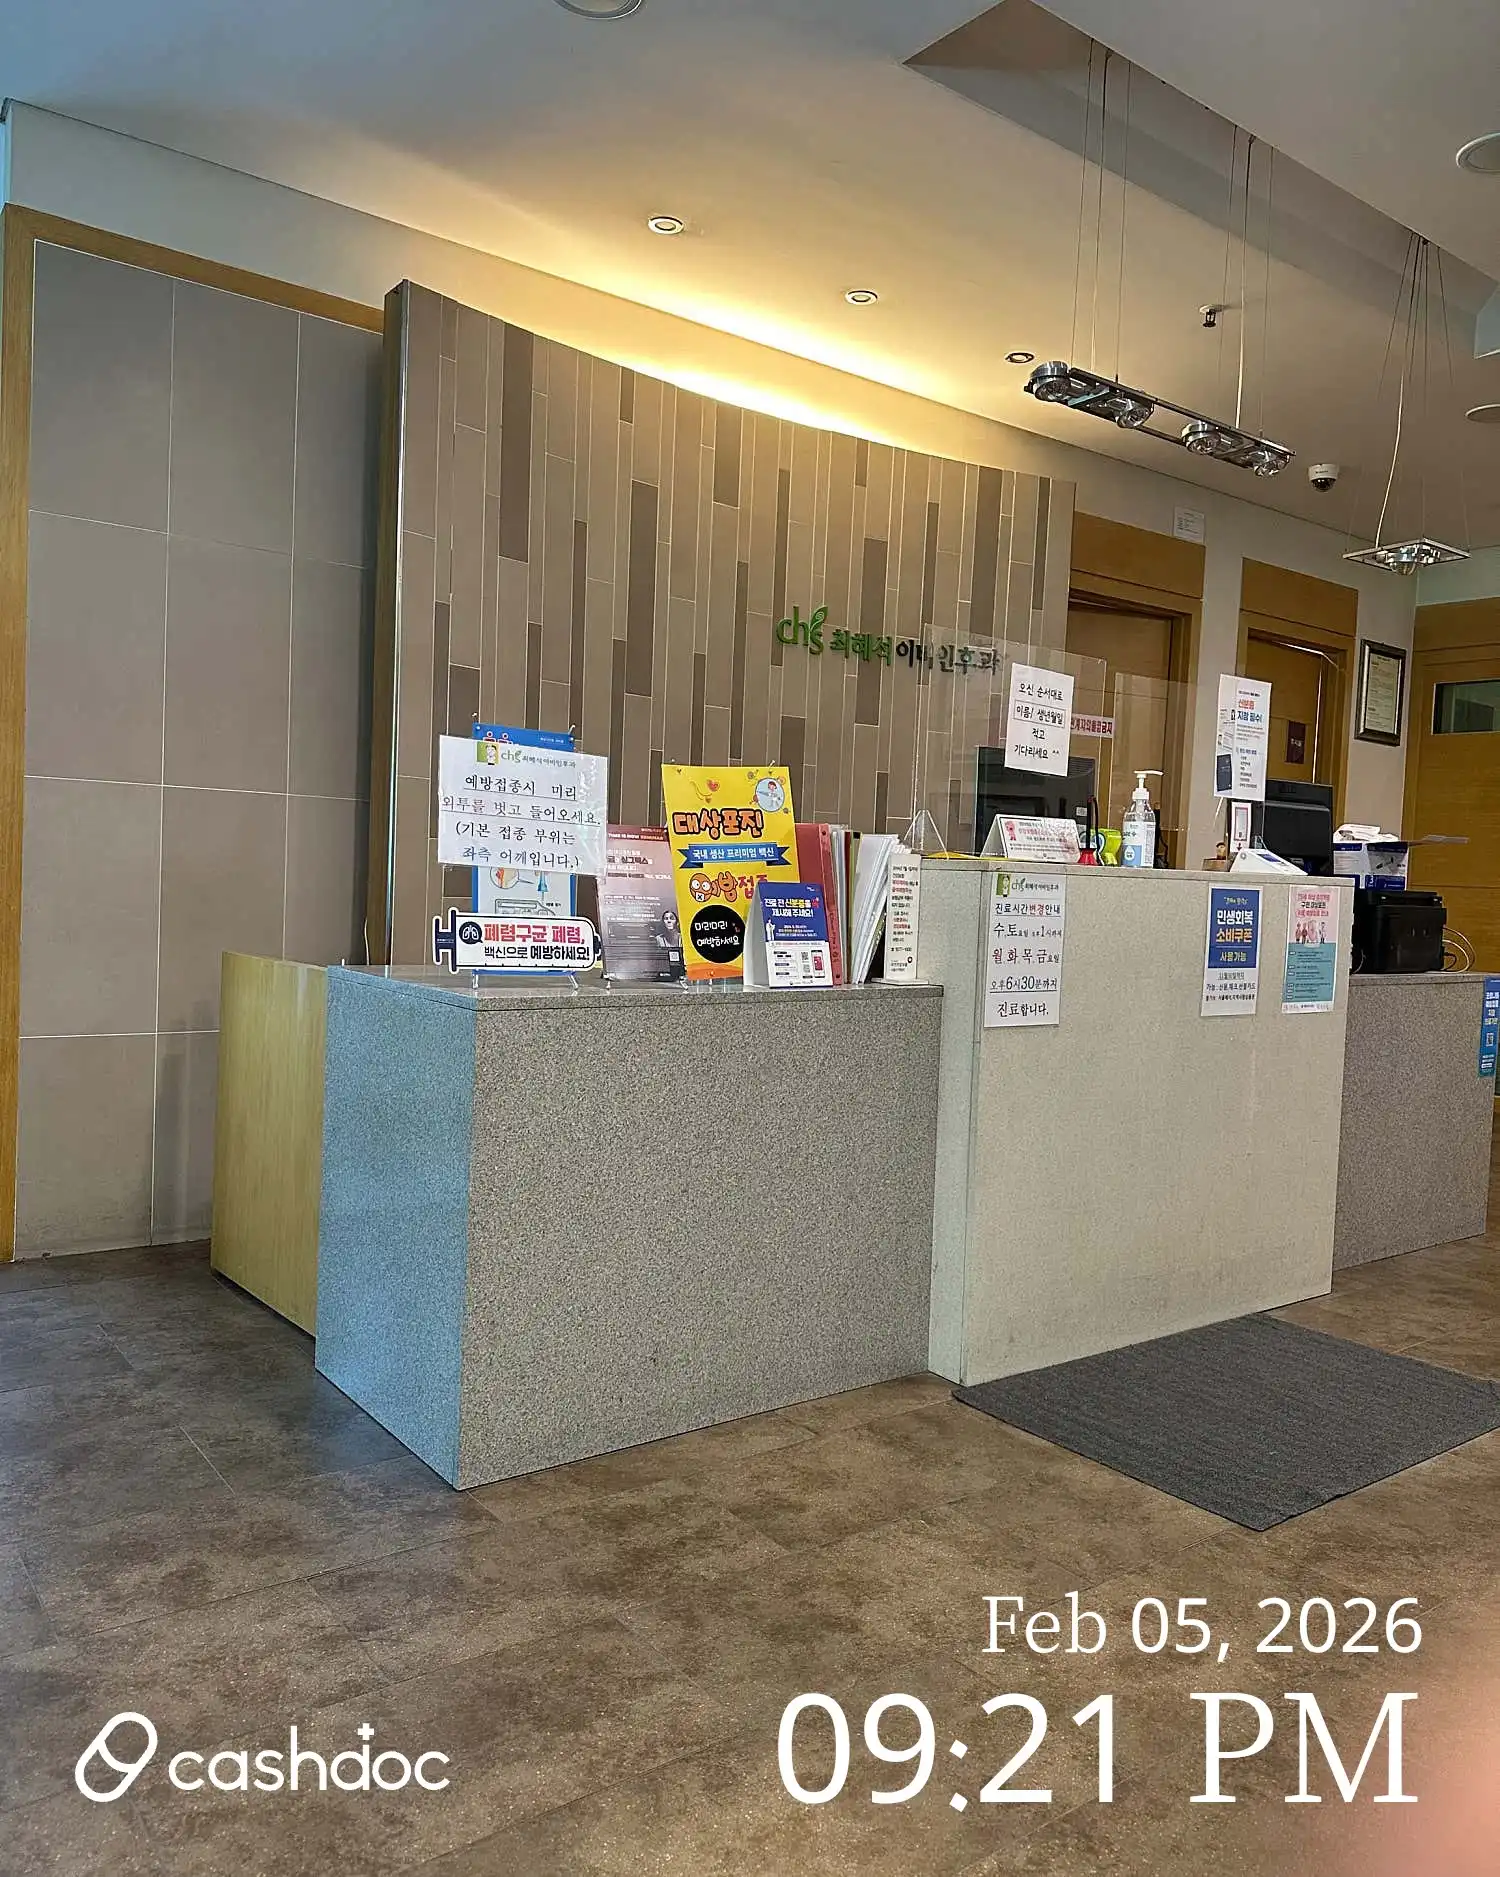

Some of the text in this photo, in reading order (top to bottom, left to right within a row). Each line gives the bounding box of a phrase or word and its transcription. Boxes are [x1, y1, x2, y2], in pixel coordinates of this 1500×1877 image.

[1019, 683, 1063, 701] 오신 순서대로
[1037, 708, 1063, 725] 생년월일
[1032, 727, 1045, 740] 적고
[1014, 745, 1048, 759] 기다리세요
[465, 774, 577, 801] 예방접종시 미리
[442, 795, 601, 825] 외투를 벗고 들어오세요.
[672, 808, 764, 840] 대상포진
[455, 821, 576, 845] (기본 접종 부위는
[462, 846, 579, 869] 좌측 어깨입니다.)
[692, 849, 708, 860] 국내
[710, 848, 725, 858] 생산
[758, 847, 775, 857] 백신
[694, 920, 728, 931] 미리미리
[1216, 909, 1254, 926] 민생회복
[484, 923, 585, 944] 폐렴구균 폐렴,
[696, 935, 740, 948] 예방하세요
[1215, 928, 1252, 943] 소비쿠폰
[484, 946, 528, 959] 백신으로
[530, 945, 590, 961] 예방하세요!
[997, 1002, 1049, 1018] 진료합니다.
